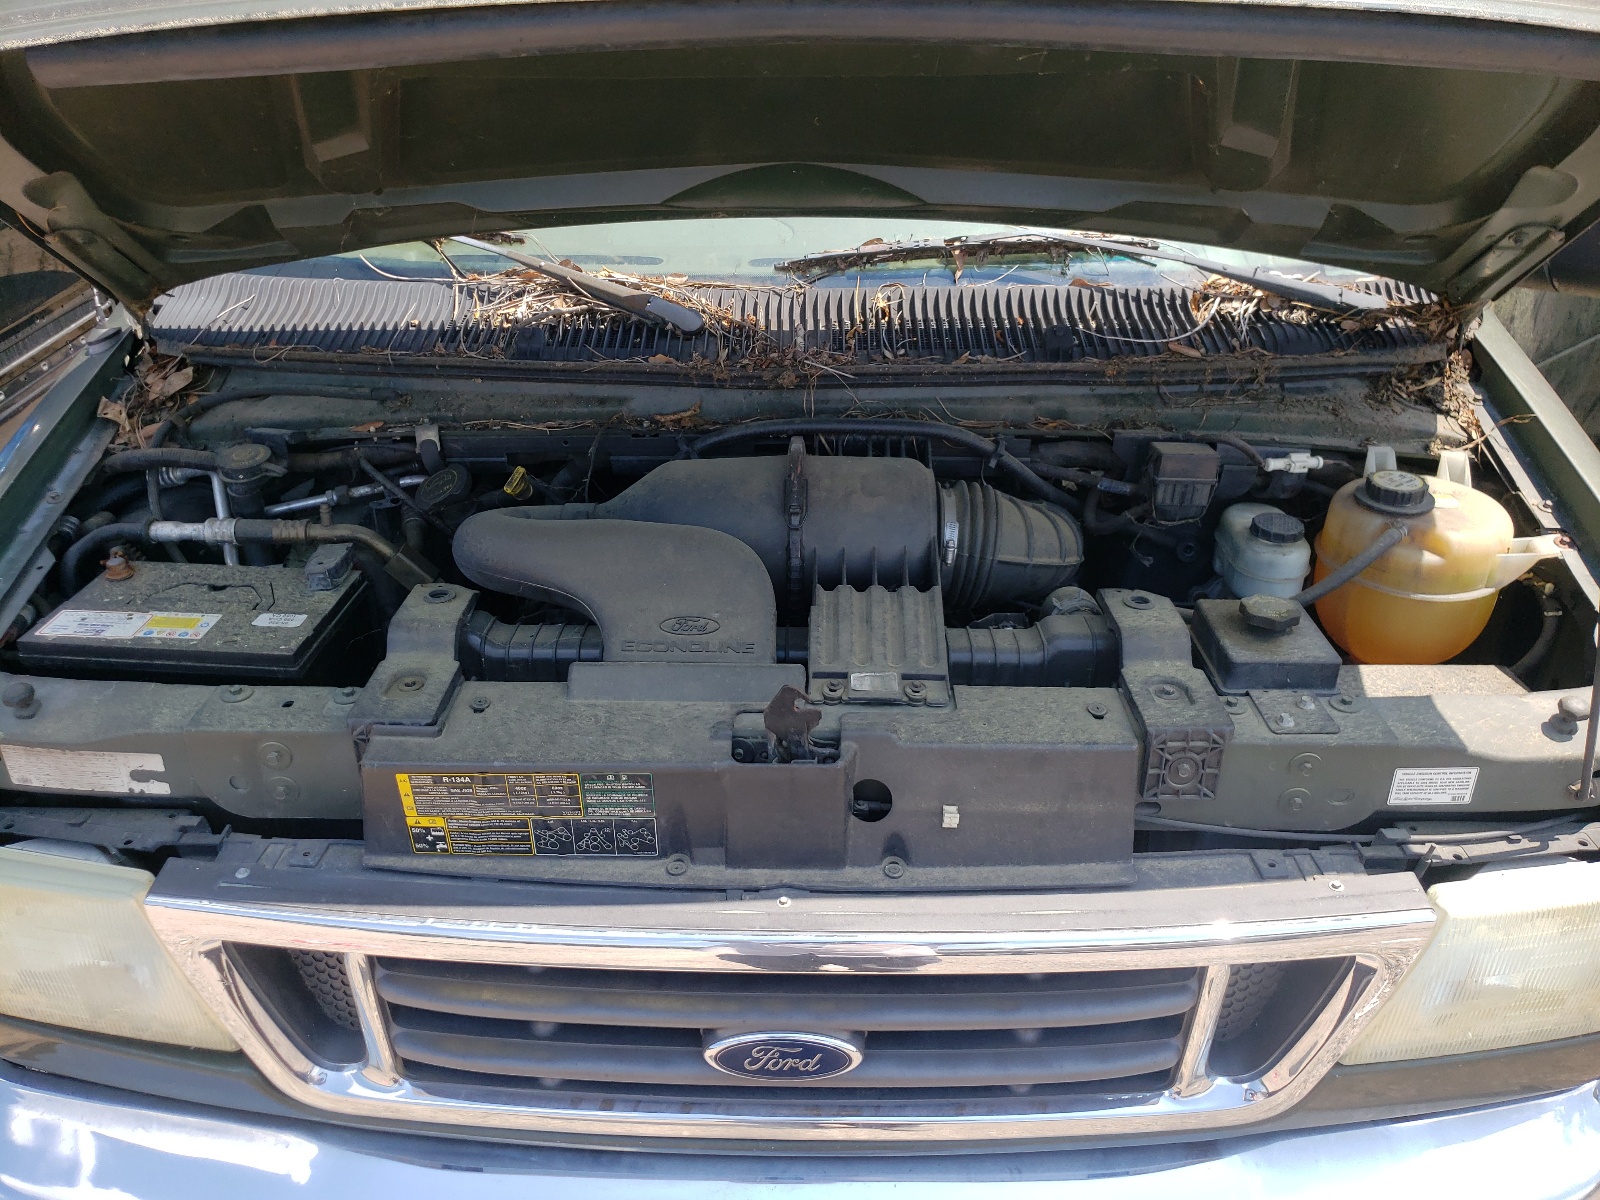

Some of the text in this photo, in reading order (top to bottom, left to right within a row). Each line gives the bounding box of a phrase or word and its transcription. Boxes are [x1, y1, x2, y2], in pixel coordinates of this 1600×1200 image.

[672, 618, 709, 632] Ford
[621, 640, 755, 654] ECONOLINE
[743, 1045, 823, 1072] Ford
